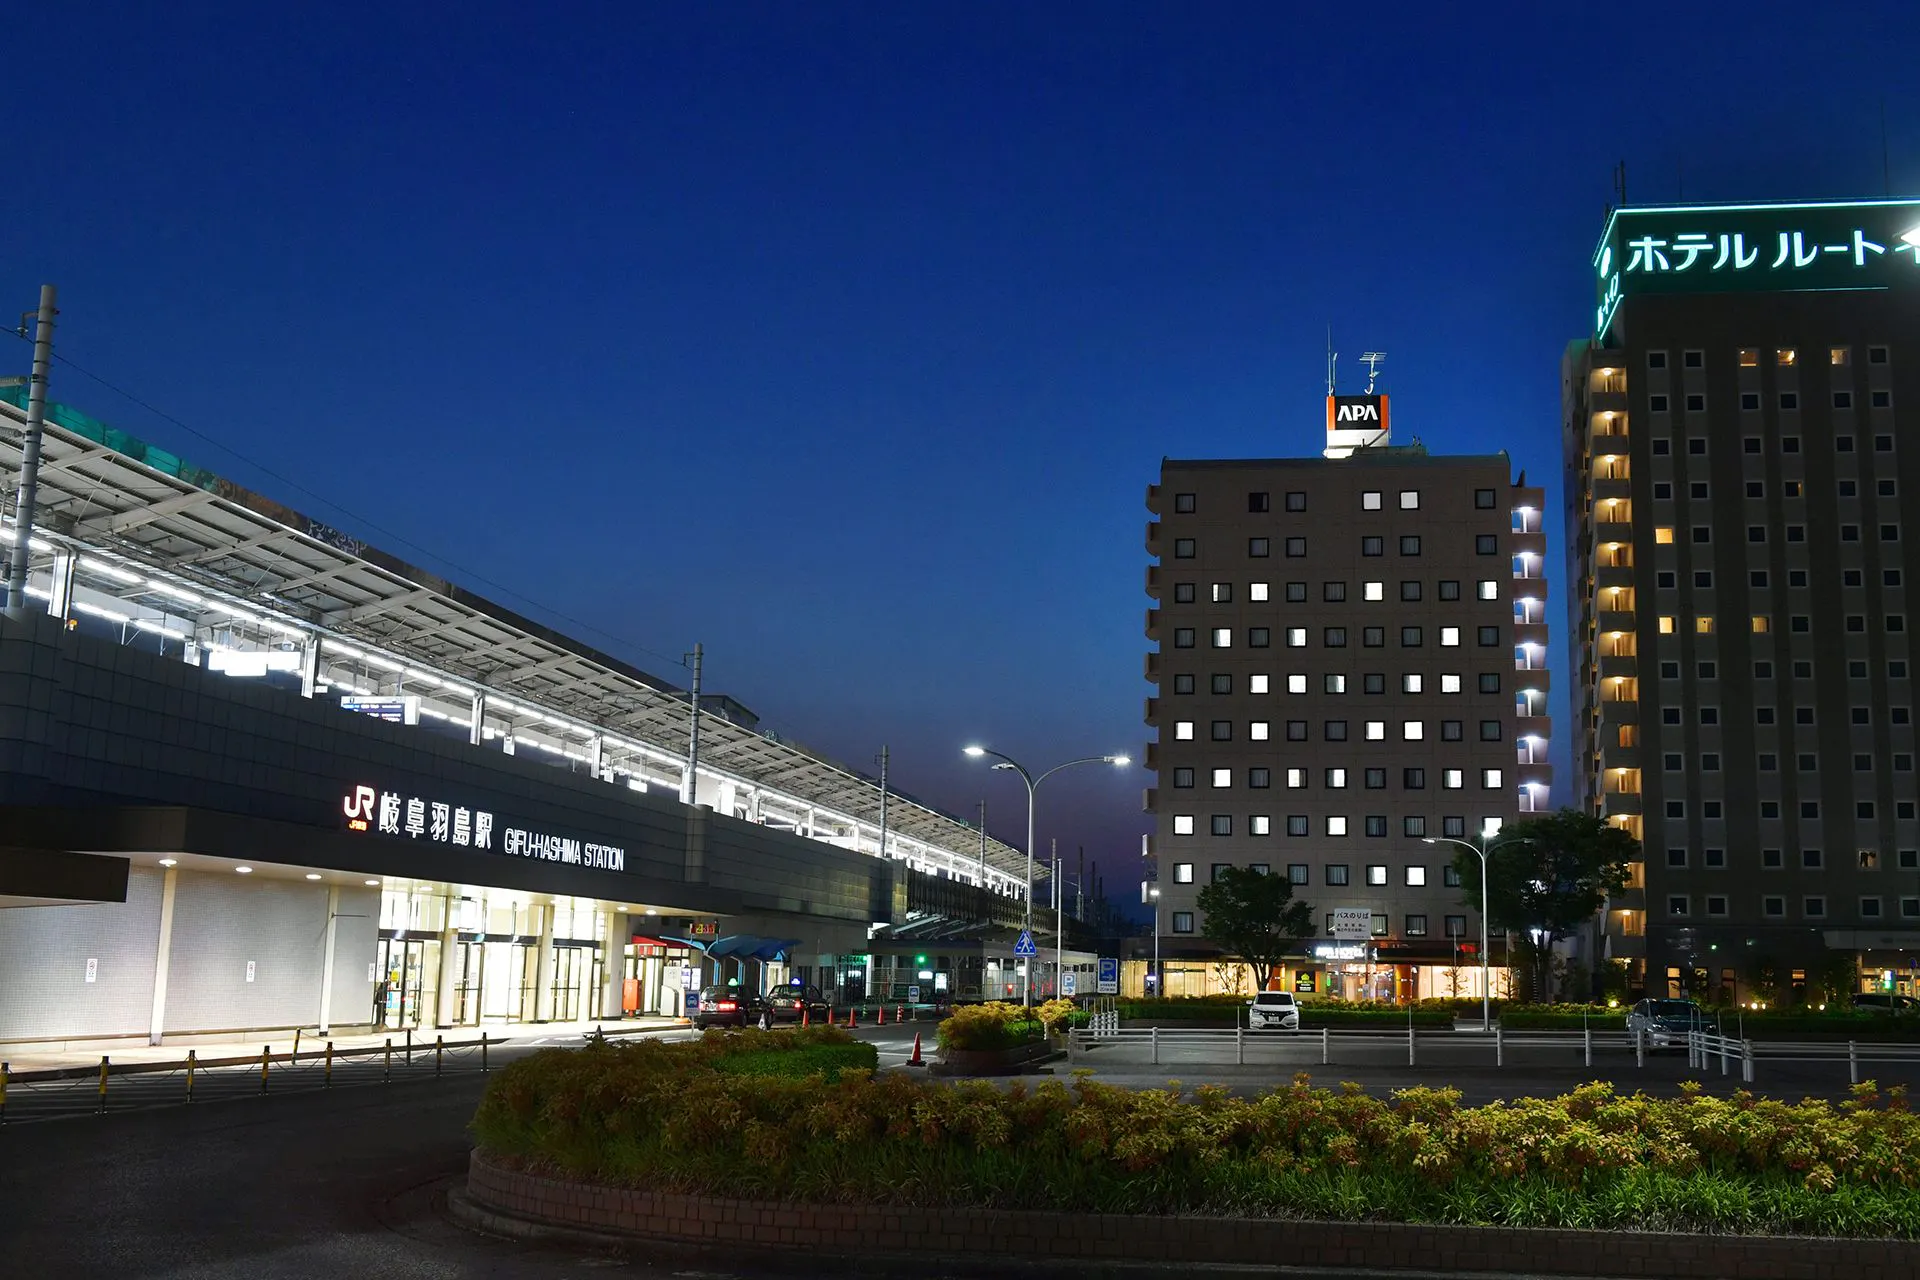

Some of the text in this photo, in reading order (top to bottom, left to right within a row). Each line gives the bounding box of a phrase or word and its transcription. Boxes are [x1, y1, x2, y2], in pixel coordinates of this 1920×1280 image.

[1626, 233, 1759, 272] ホテル
[1337, 404, 1379, 422] APA
[343, 785, 375, 821] JR
[378, 791, 493, 850] 岐阜羽島駅
[504, 827, 624, 871] GIFU-HASHIMA STATION
[1336, 912, 1370, 920] バスのりば
[1064, 975, 1074, 986] P
[1100, 961, 1115, 975] P
